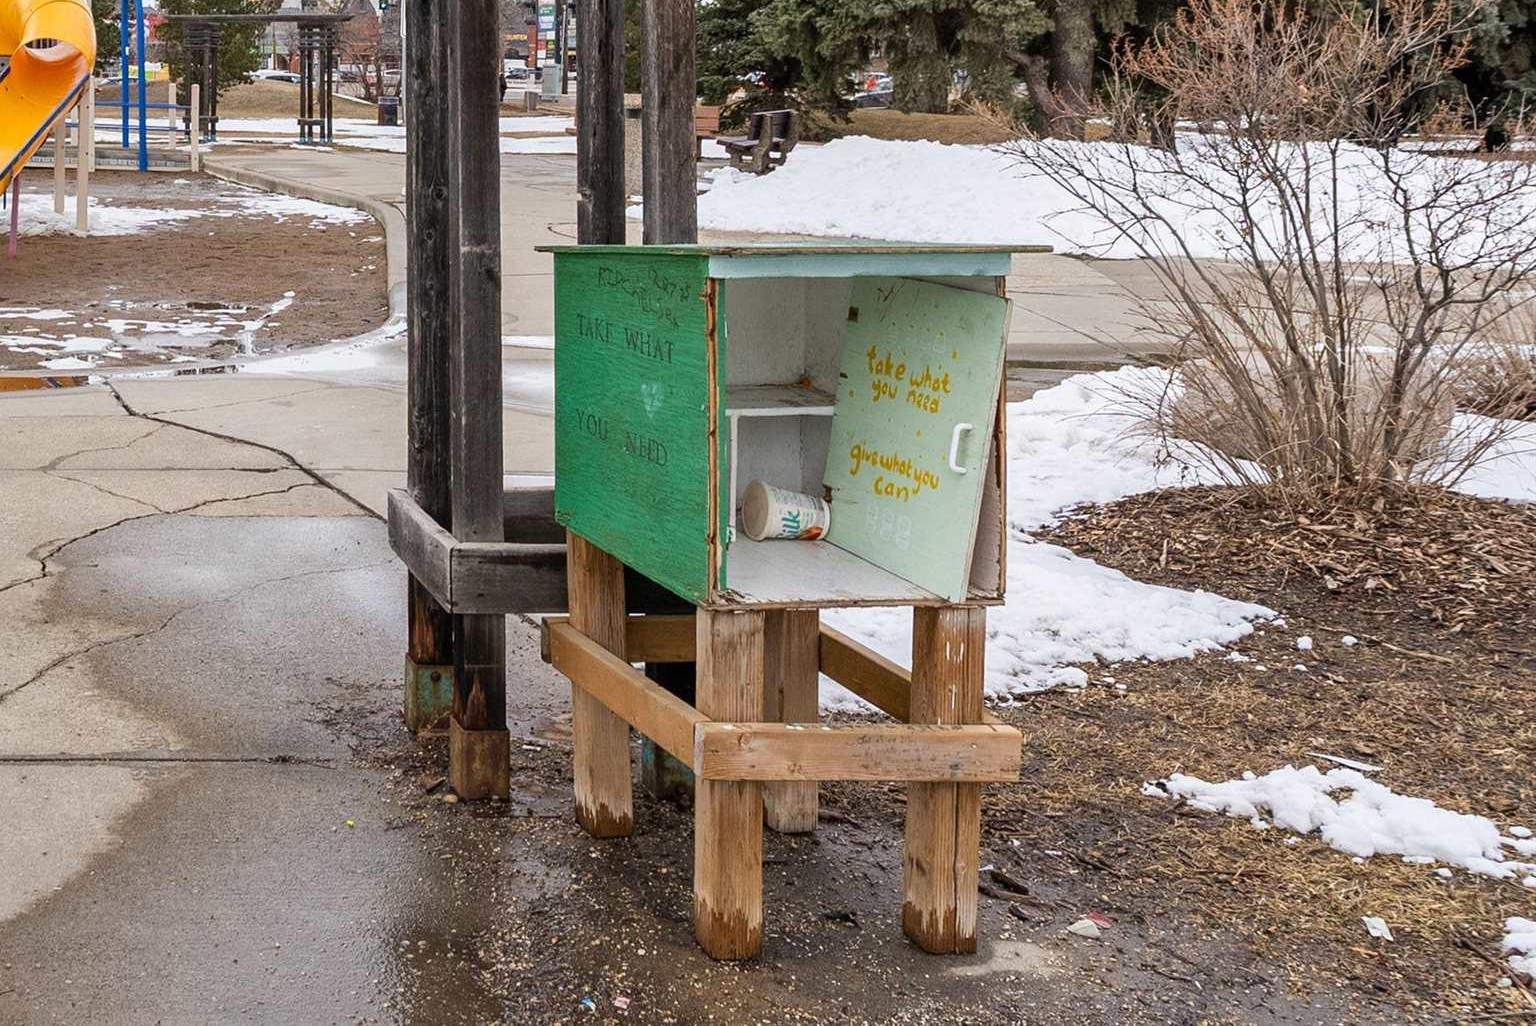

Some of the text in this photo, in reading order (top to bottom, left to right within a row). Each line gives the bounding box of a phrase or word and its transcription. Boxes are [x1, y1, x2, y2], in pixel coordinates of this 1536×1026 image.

[576, 313, 674, 364] TAKE WHAT
[867, 344, 951, 394] take what
[872, 379, 897, 403] you
[576, 408, 669, 467] YOU NEED
[912, 466, 940, 495] you
